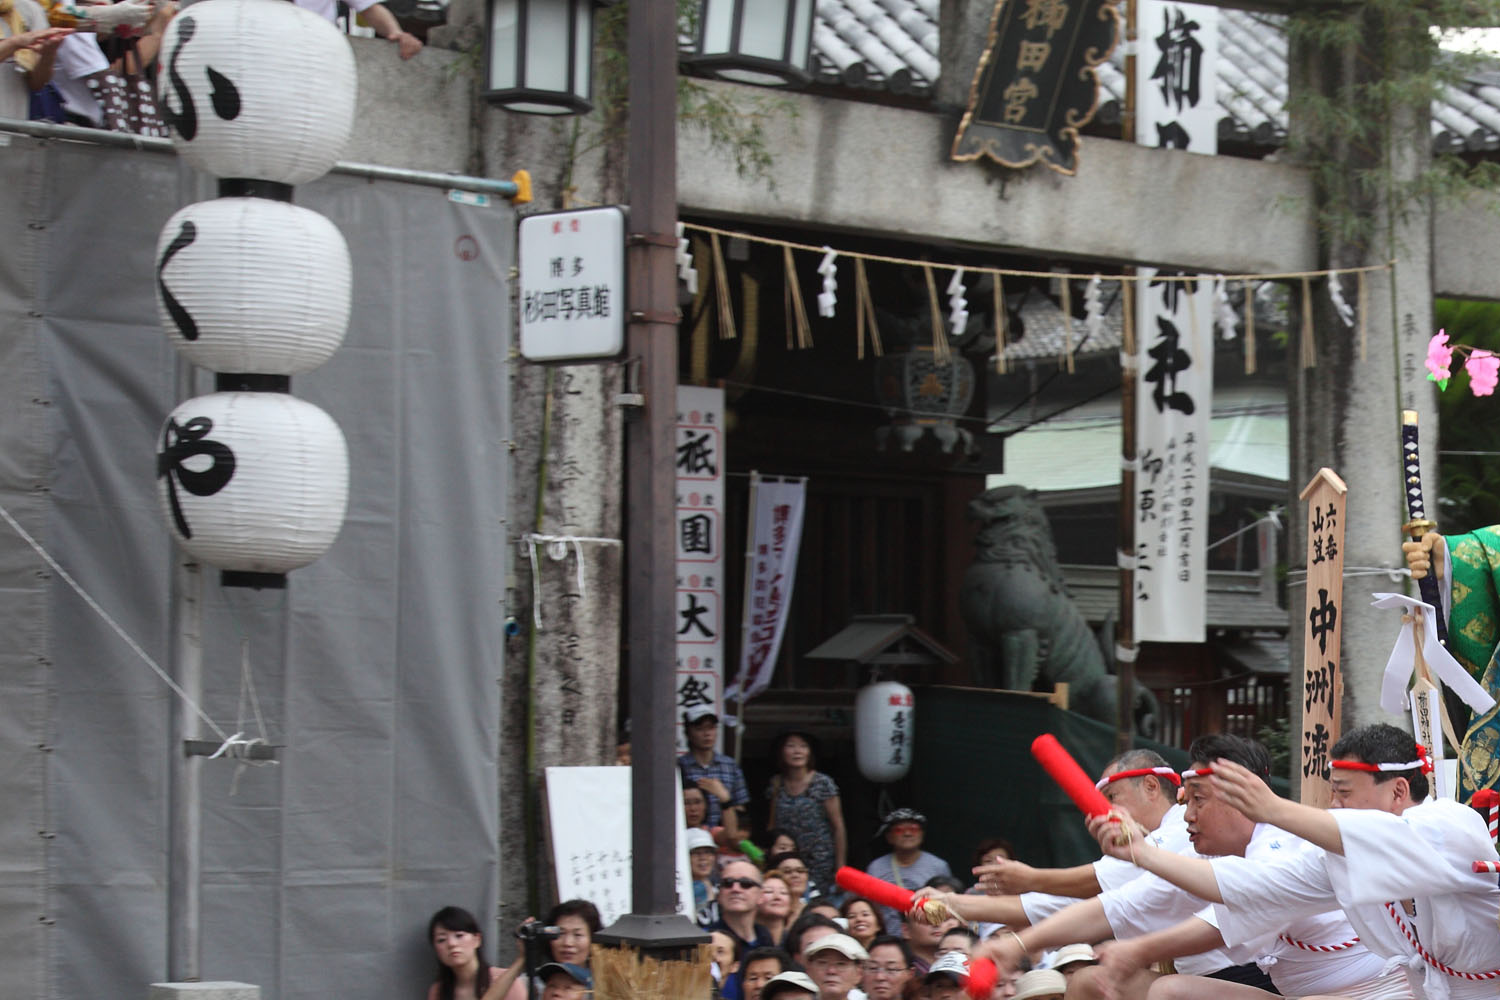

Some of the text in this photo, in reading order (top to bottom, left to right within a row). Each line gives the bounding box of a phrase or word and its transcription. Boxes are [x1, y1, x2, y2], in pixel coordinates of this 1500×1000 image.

[551, 256, 584, 278] 博多
[525, 284, 610, 324] 杉田写真館
[1310, 506, 1327, 565] 山笠
[1323, 502, 1339, 561] 六番
[1302, 588, 1337, 782] 中洲流
